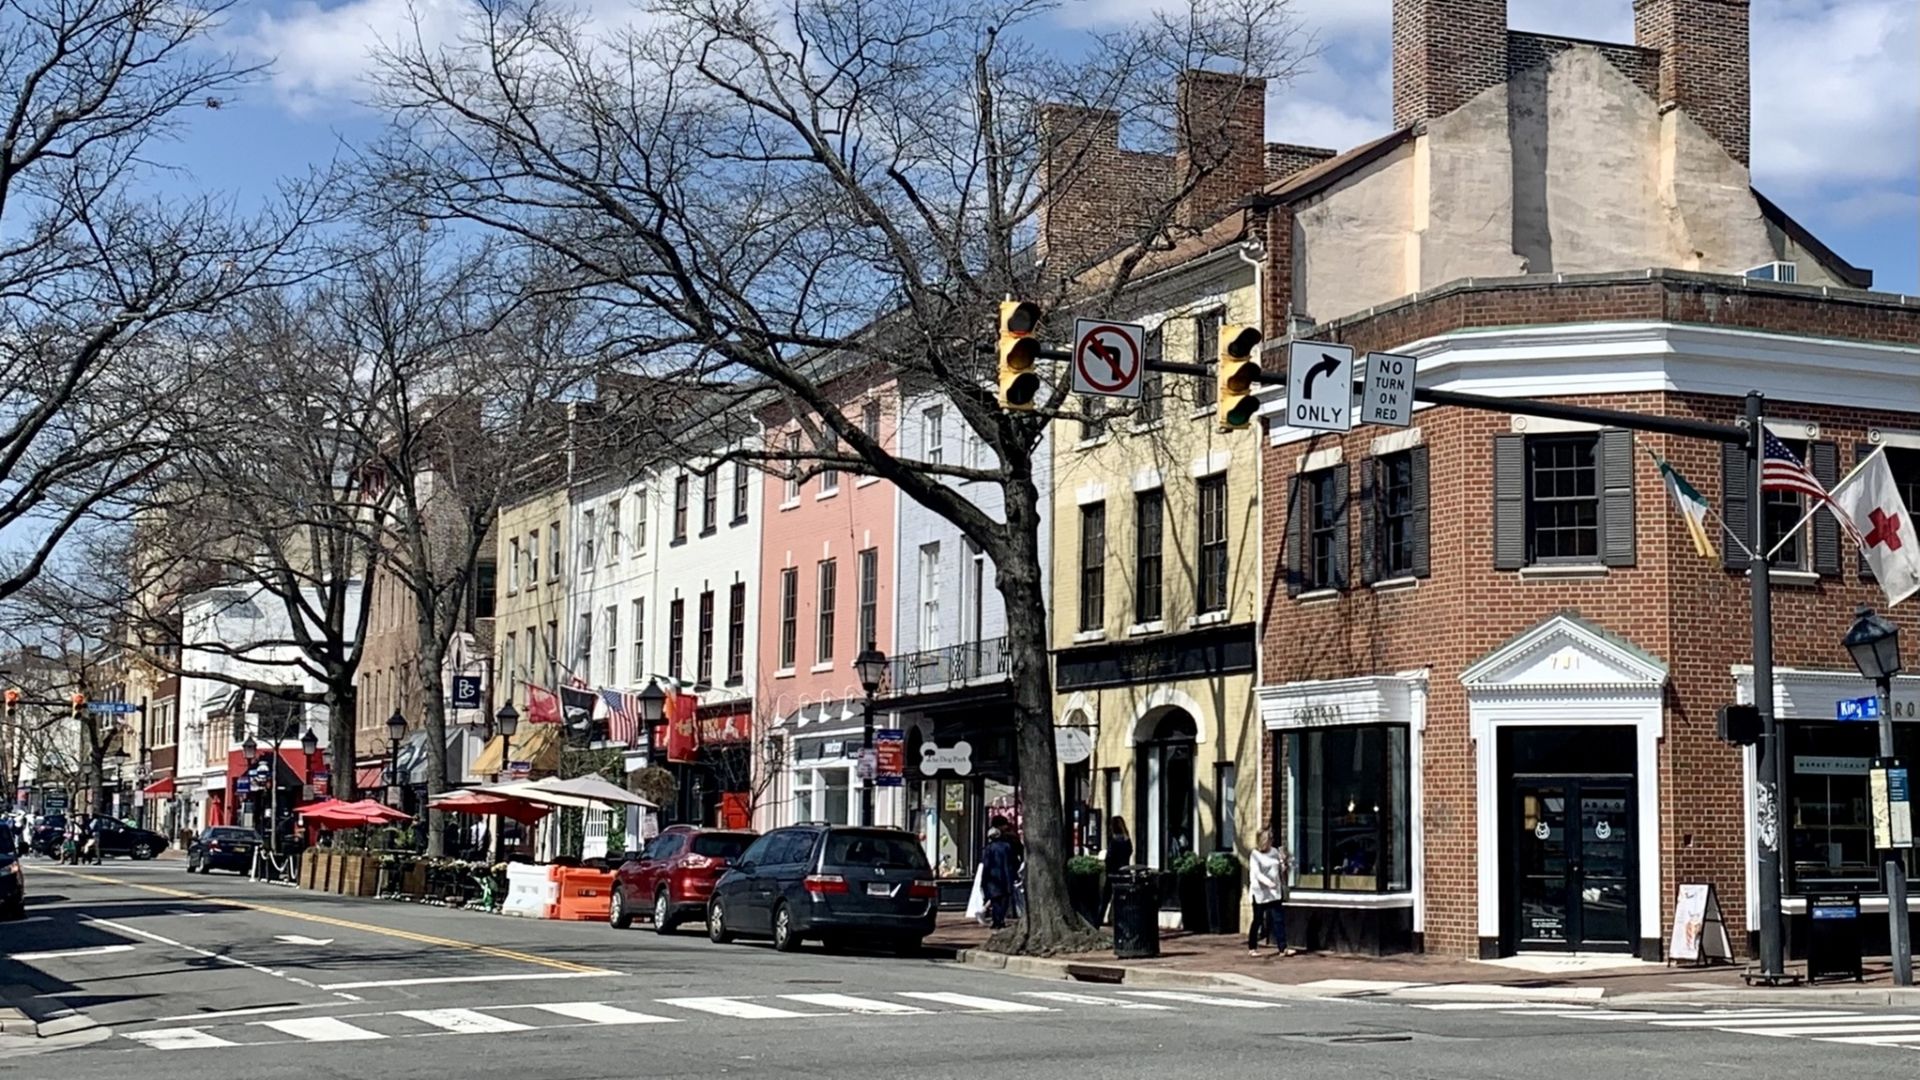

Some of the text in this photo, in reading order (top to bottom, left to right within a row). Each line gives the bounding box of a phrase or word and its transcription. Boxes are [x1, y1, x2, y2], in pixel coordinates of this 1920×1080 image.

[1379, 360, 1403, 375] NO
[1375, 377, 1405, 390] TURN
[1380, 393, 1397, 404] ON
[1296, 404, 1342, 423] ONLY
[1375, 407, 1398, 420] RED
[1841, 701, 1862, 717] King
